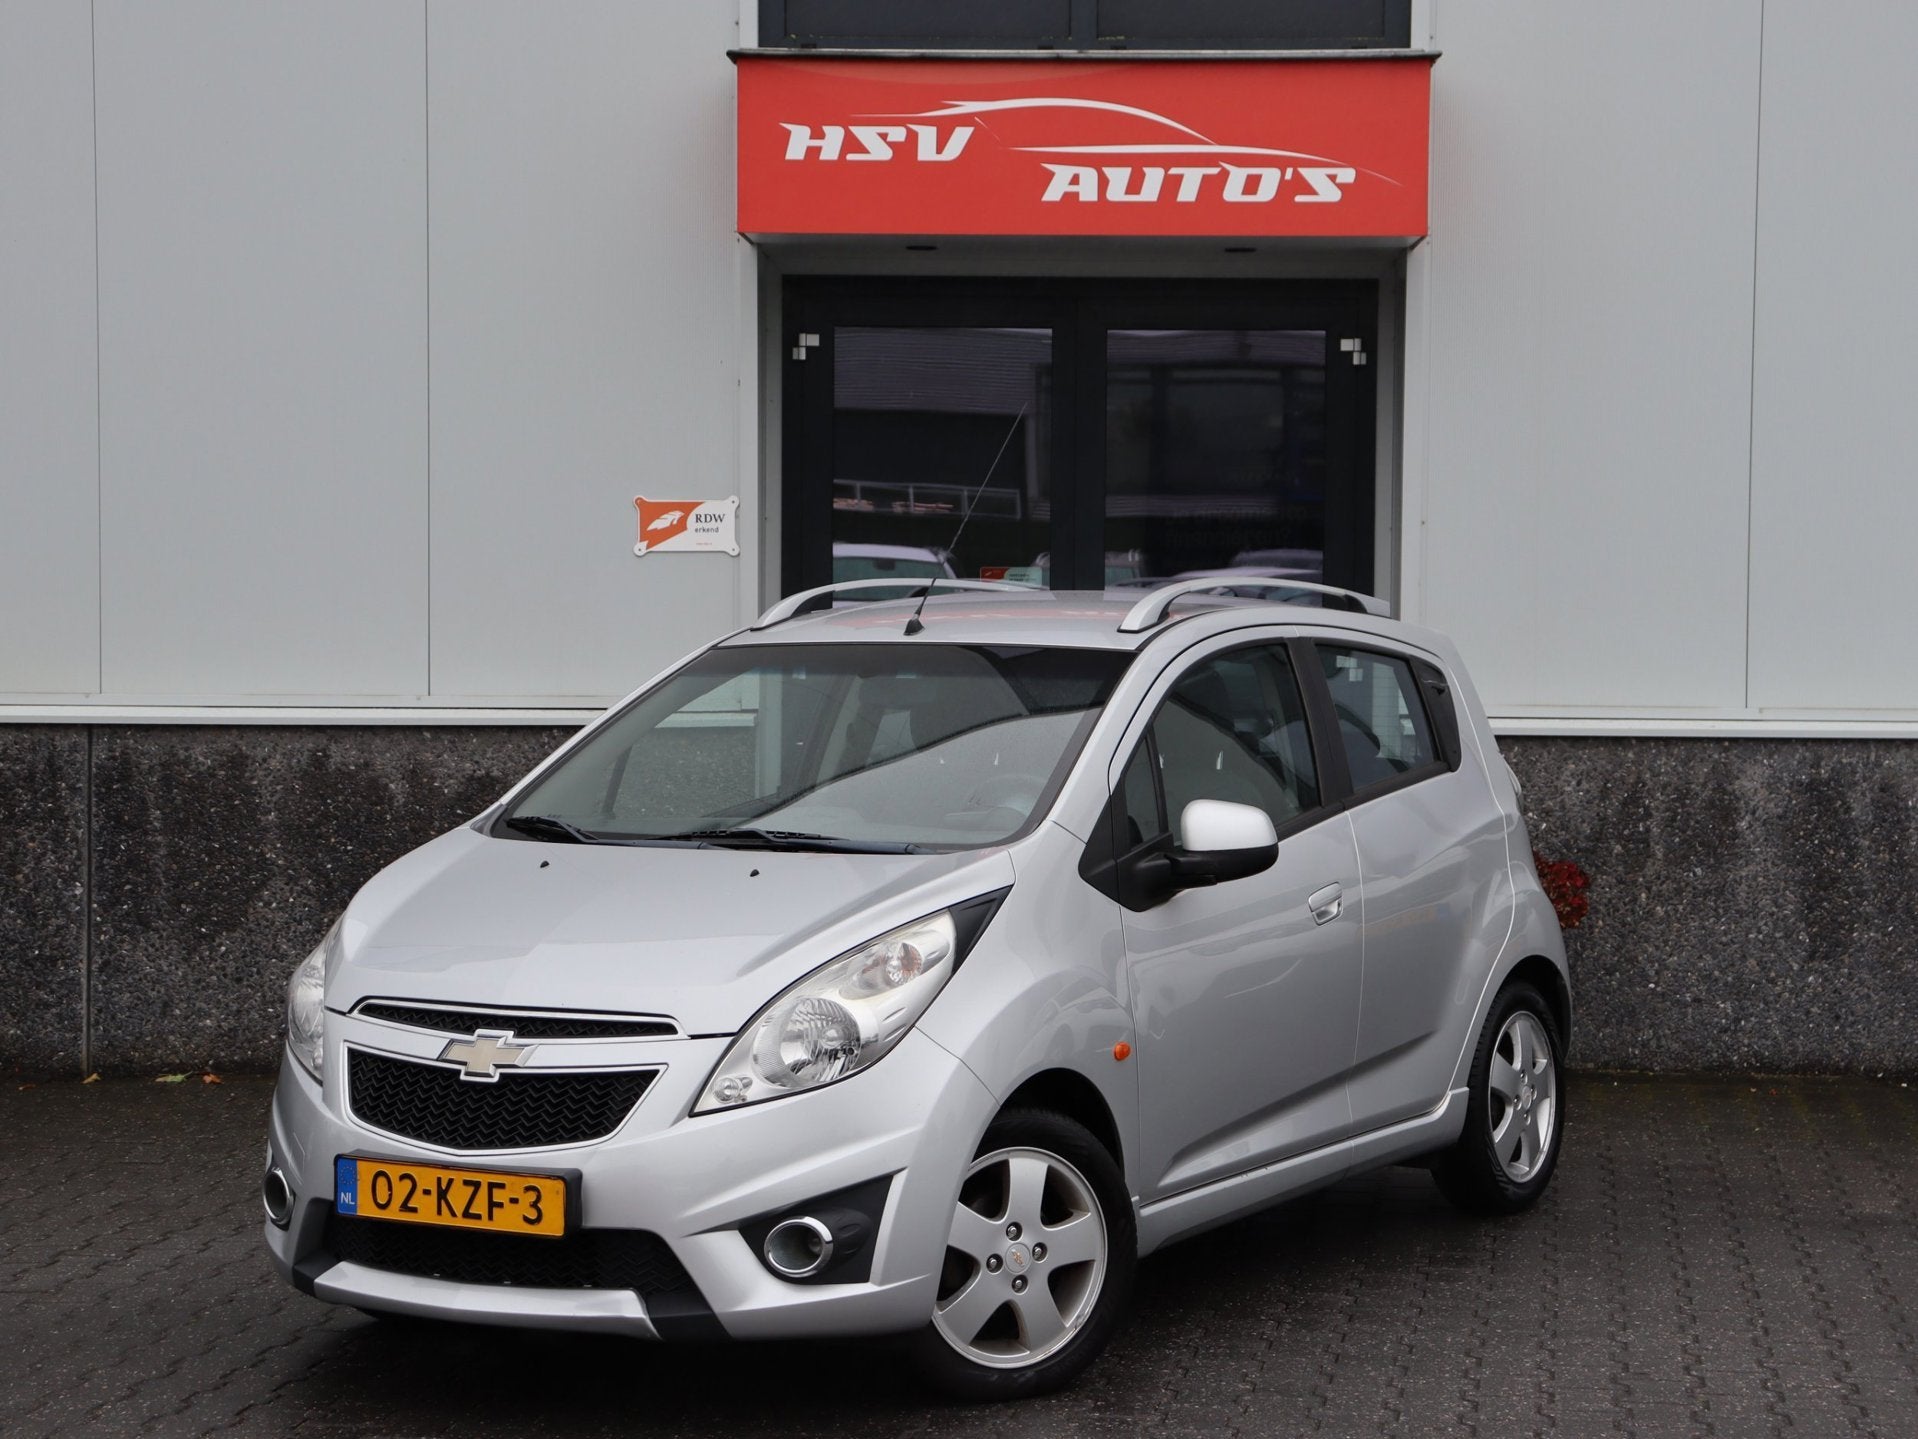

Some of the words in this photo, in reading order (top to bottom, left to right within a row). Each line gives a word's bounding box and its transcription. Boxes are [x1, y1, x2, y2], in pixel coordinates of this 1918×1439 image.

[779, 122, 975, 162] HSV
[1040, 161, 1357, 203] AUTO'S
[694, 526, 720, 534] erkend
[695, 513, 726, 524] RDW
[340, 1191, 355, 1205] NL
[371, 1169, 544, 1226] 02-KZF-3
